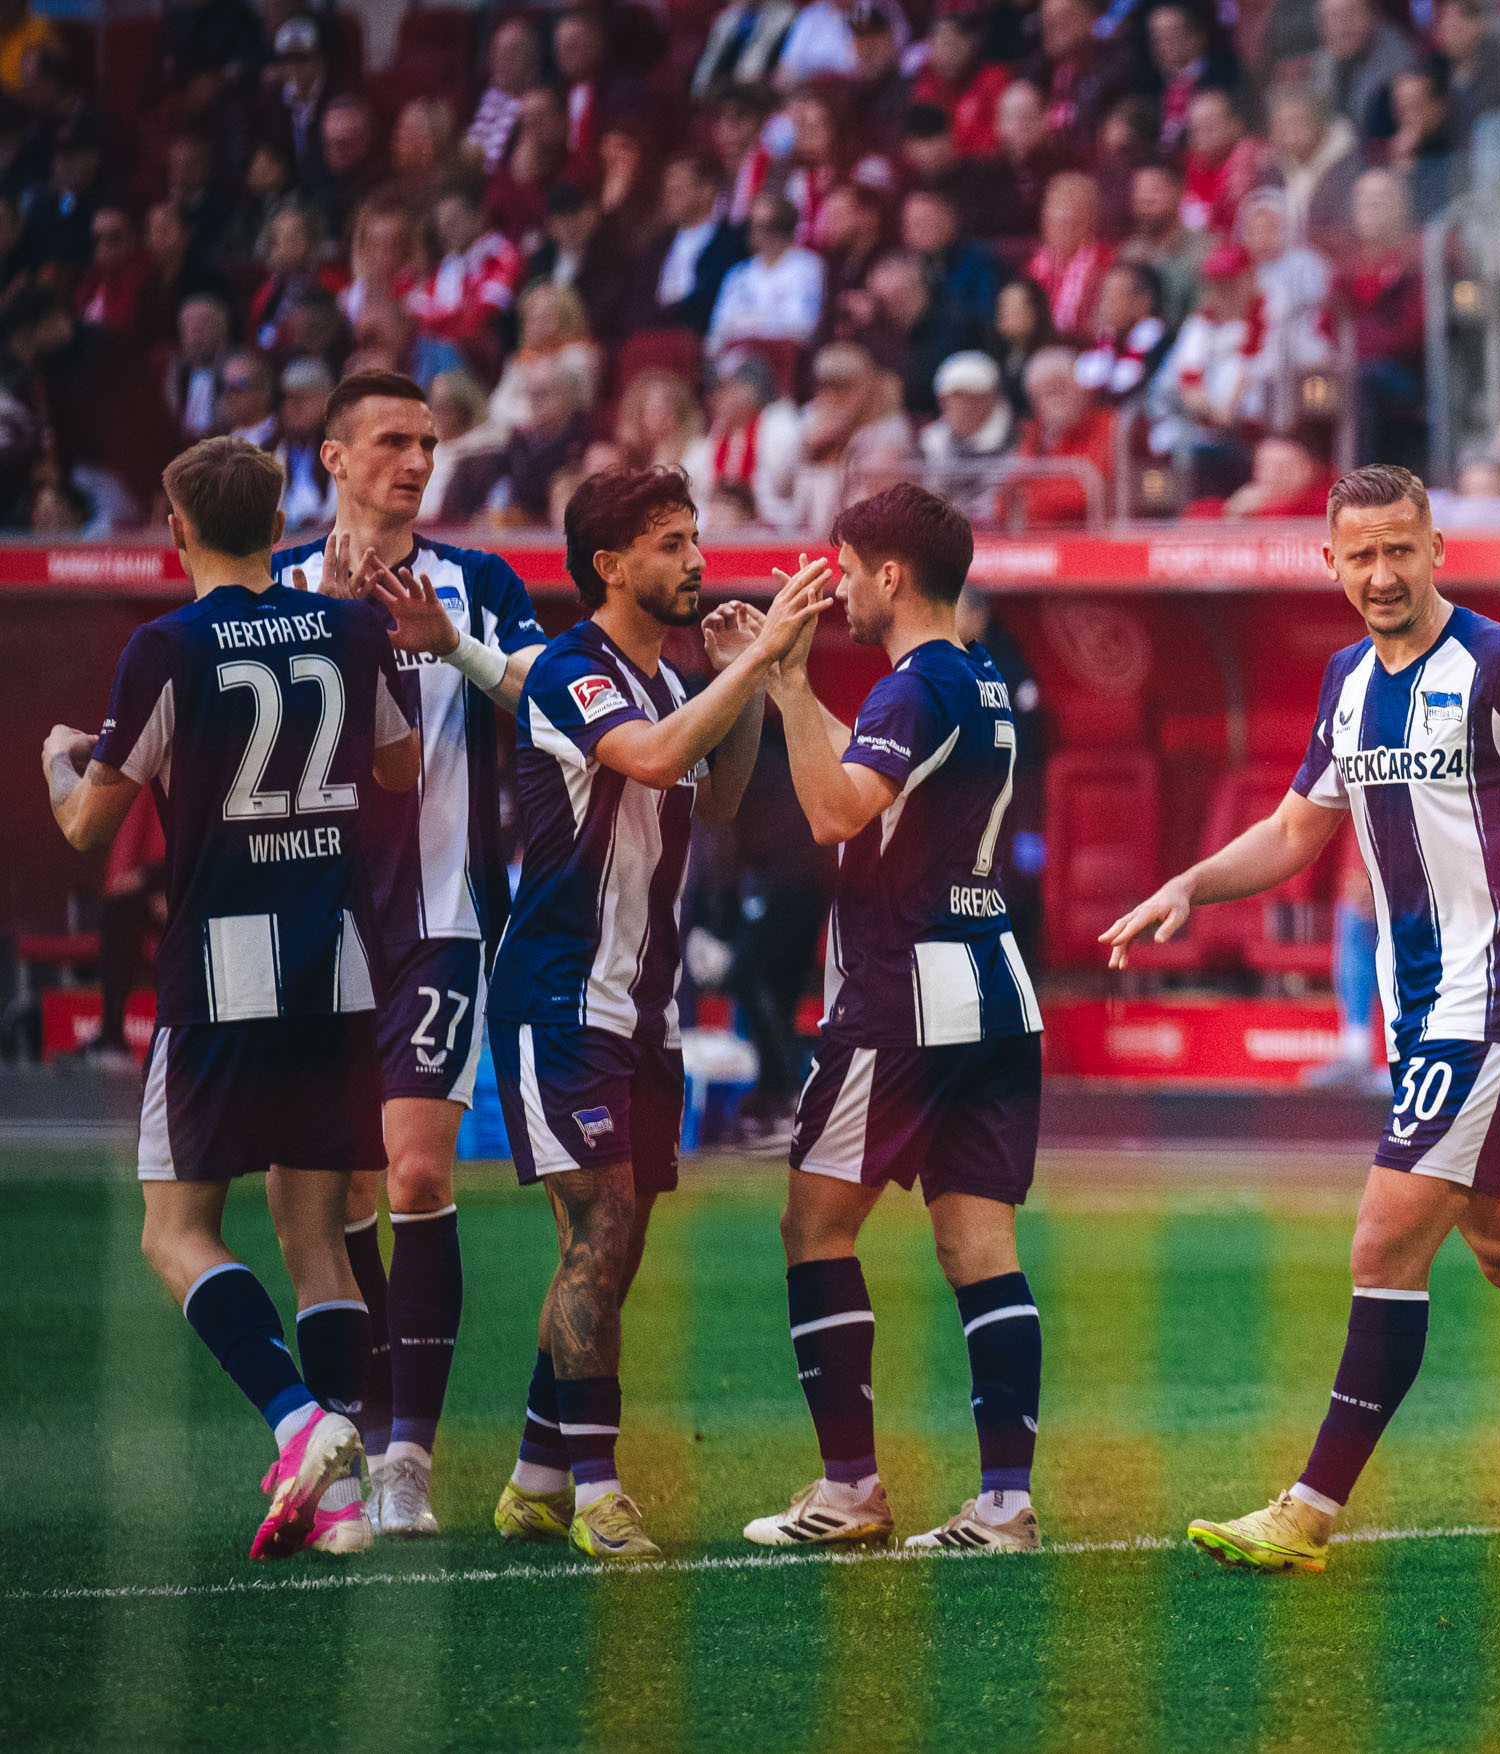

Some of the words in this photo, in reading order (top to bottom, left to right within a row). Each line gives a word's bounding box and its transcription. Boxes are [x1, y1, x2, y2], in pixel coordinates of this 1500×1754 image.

[212, 617, 296, 650] HERTHA
[291, 610, 333, 642] BSC
[216, 653, 360, 822] 22
[1333, 748, 1464, 784] HECKCARS24
[971, 719, 1017, 877] 7
[249, 826, 342, 864] WINKLER
[410, 985, 469, 1051] 27
[1392, 1057, 1453, 1121] 30
